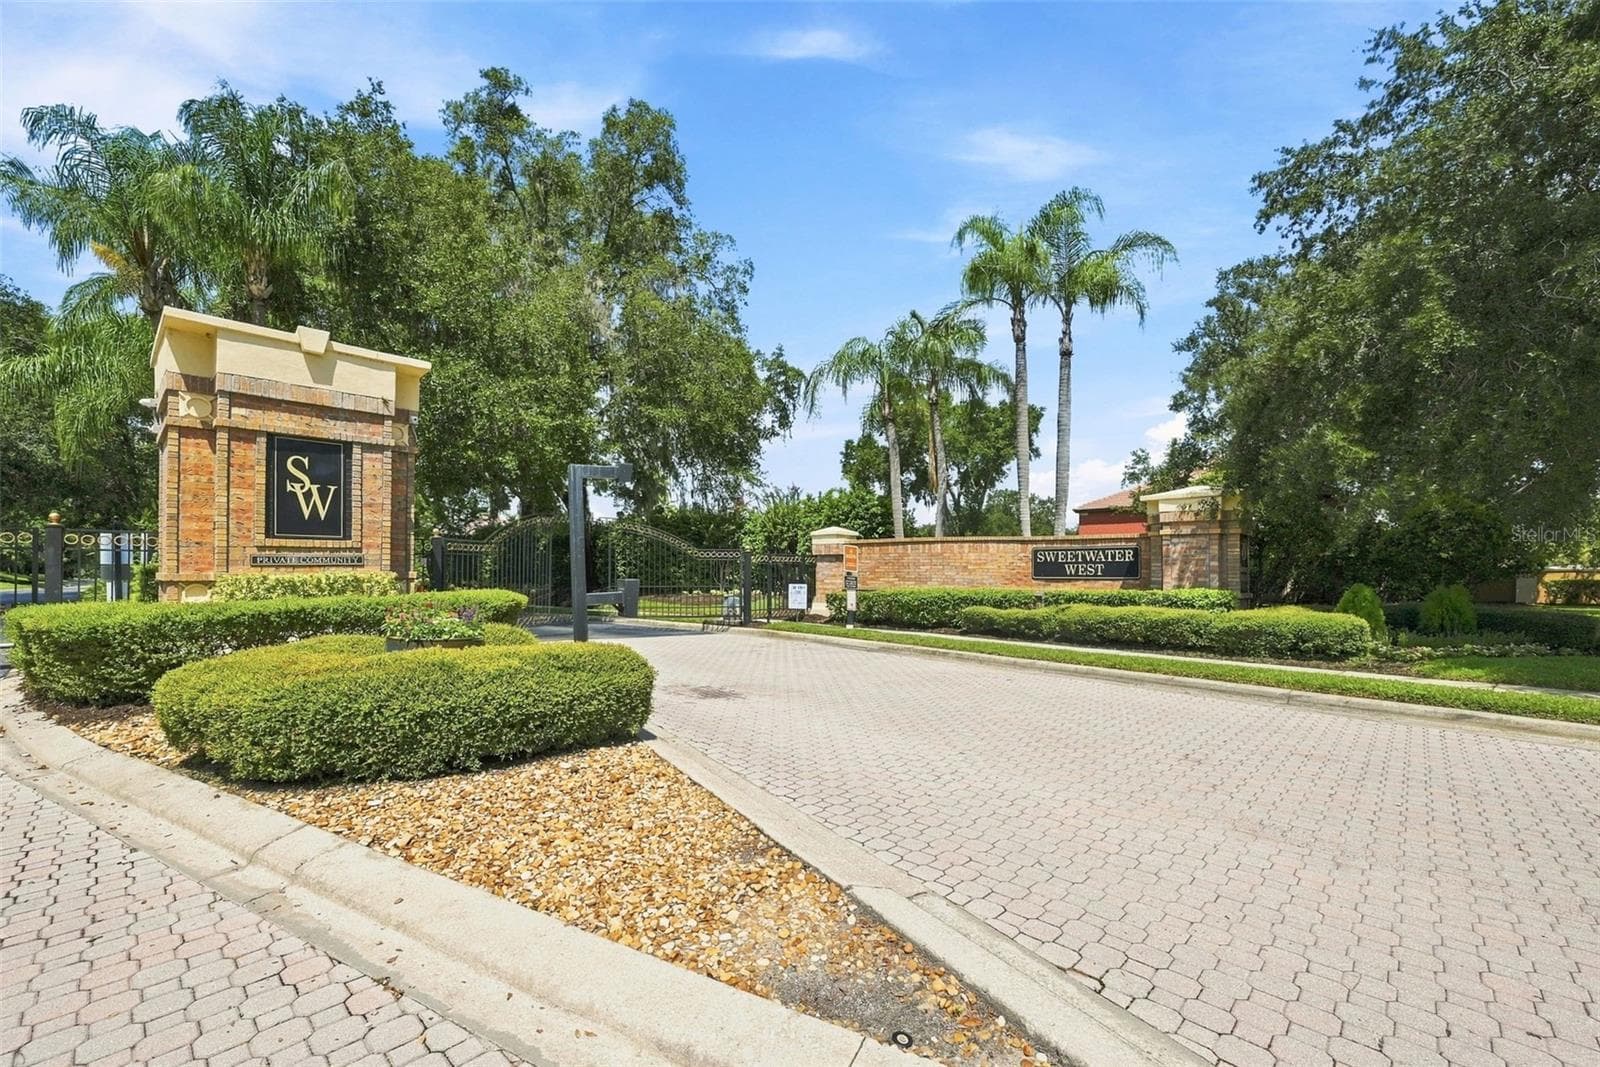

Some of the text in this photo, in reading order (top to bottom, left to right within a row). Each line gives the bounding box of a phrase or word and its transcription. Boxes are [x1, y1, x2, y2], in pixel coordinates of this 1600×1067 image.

[256, 556, 297, 564] PRIVATE
[1037, 549, 1135, 563] SWEETWATER
[1065, 563, 1104, 576] WEST
